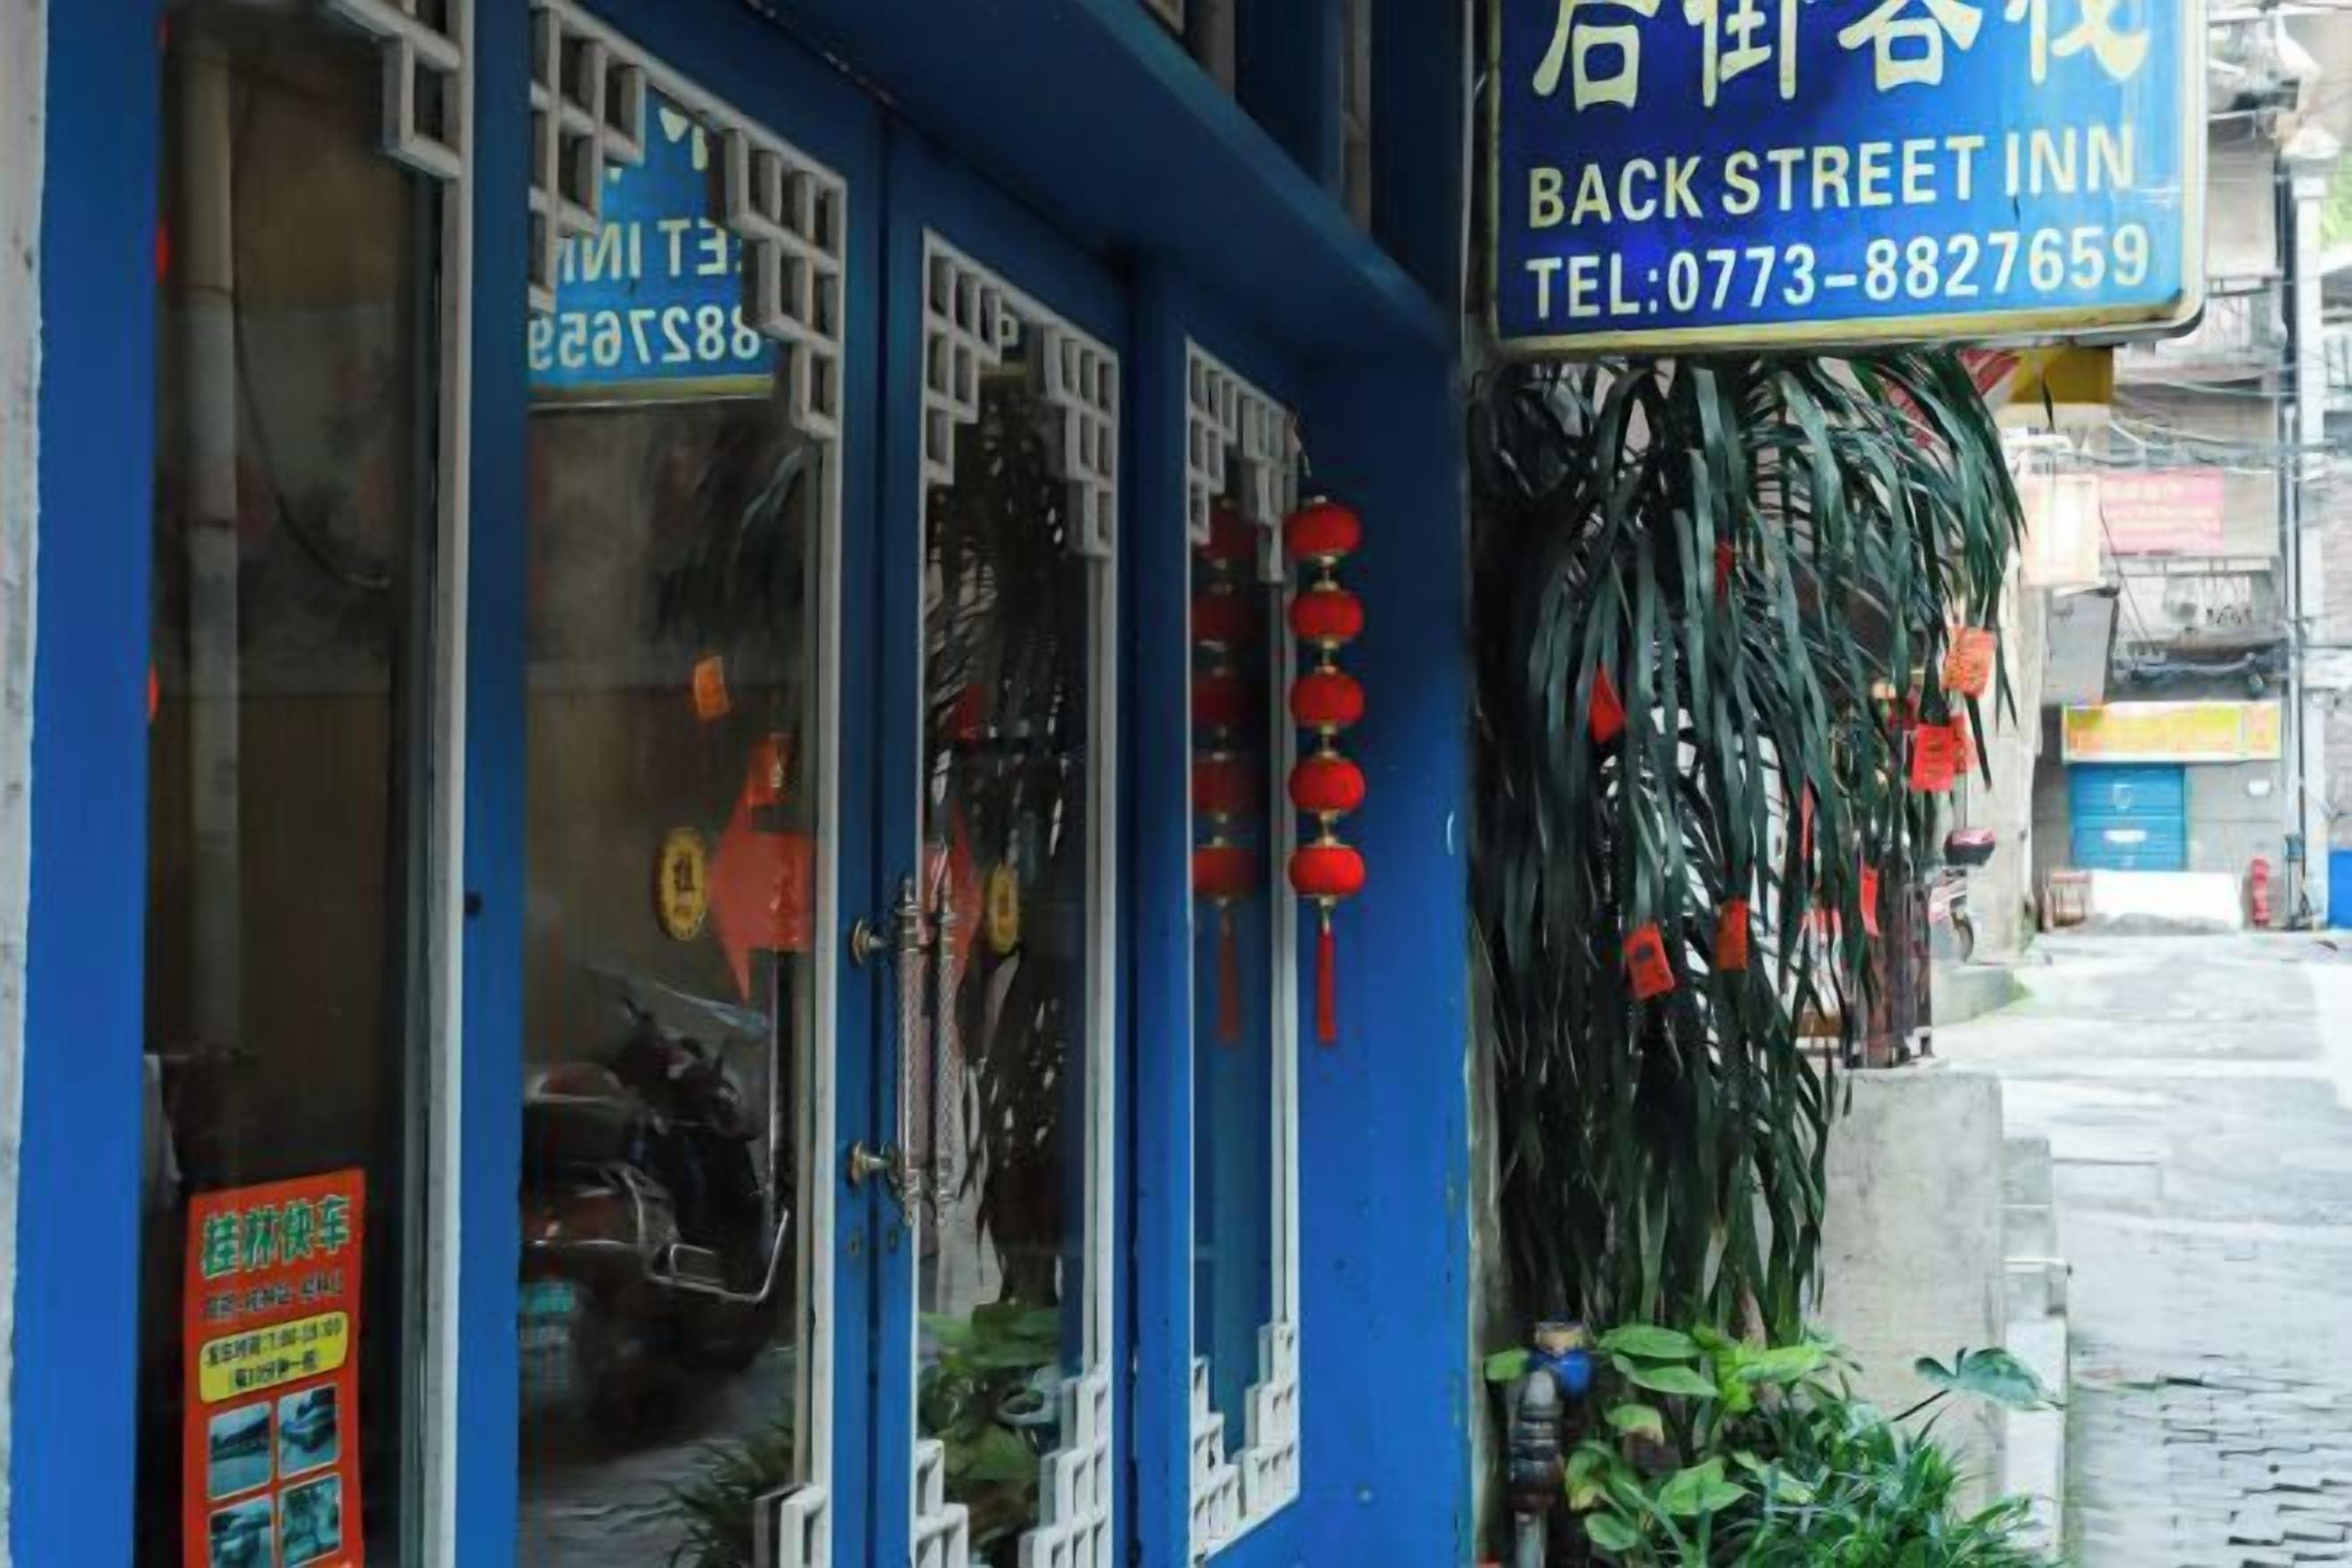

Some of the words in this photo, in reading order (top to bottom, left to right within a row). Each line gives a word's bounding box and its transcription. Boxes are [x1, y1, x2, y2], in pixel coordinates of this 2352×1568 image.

[1529, 155, 1703, 229] BACK
[1720, 135, 1985, 216] STREET
[2005, 121, 2135, 198] INN
[1525, 224, 2149, 320] TEL:0773-8827659
